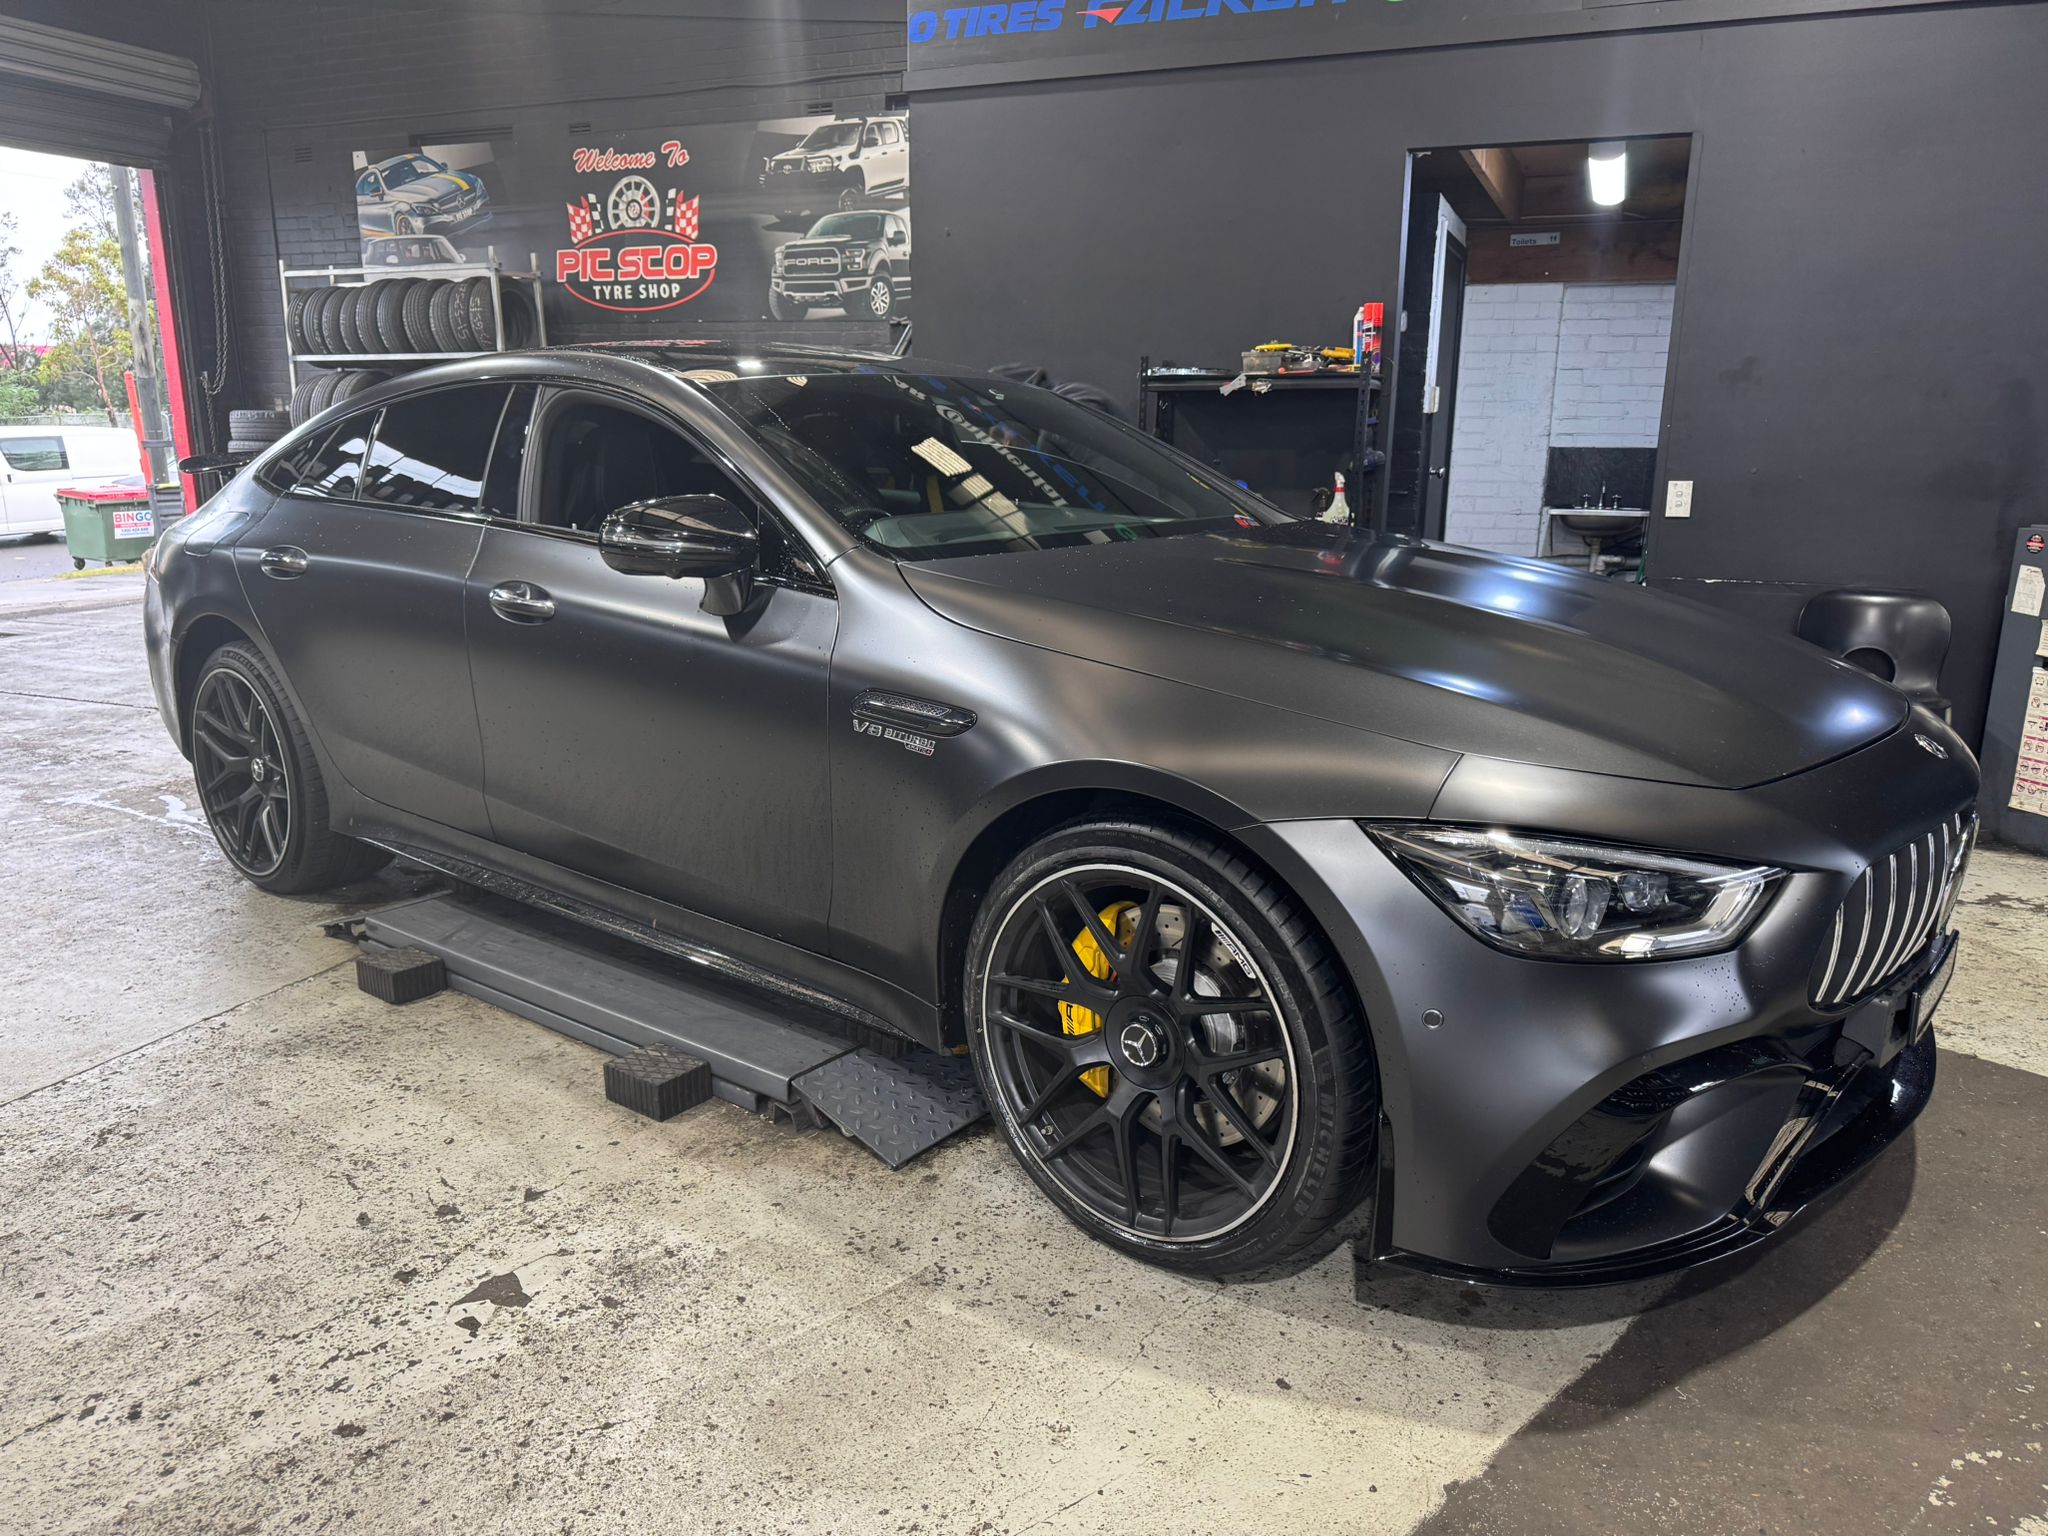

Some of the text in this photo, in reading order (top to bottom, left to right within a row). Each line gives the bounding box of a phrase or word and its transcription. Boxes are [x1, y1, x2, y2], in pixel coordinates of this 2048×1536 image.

[944, 0, 1065, 39] TIRES
[573, 140, 690, 173] Welcome To
[556, 244, 717, 282] PIT STOP
[784, 257, 840, 266] FORD
[593, 283, 680, 300] TYRE SHOP
[114, 511, 152, 522] BINGO
[853, 719, 936, 749] V8 BITURBO
[1293, 1091, 1334, 1217] MICHELIN
